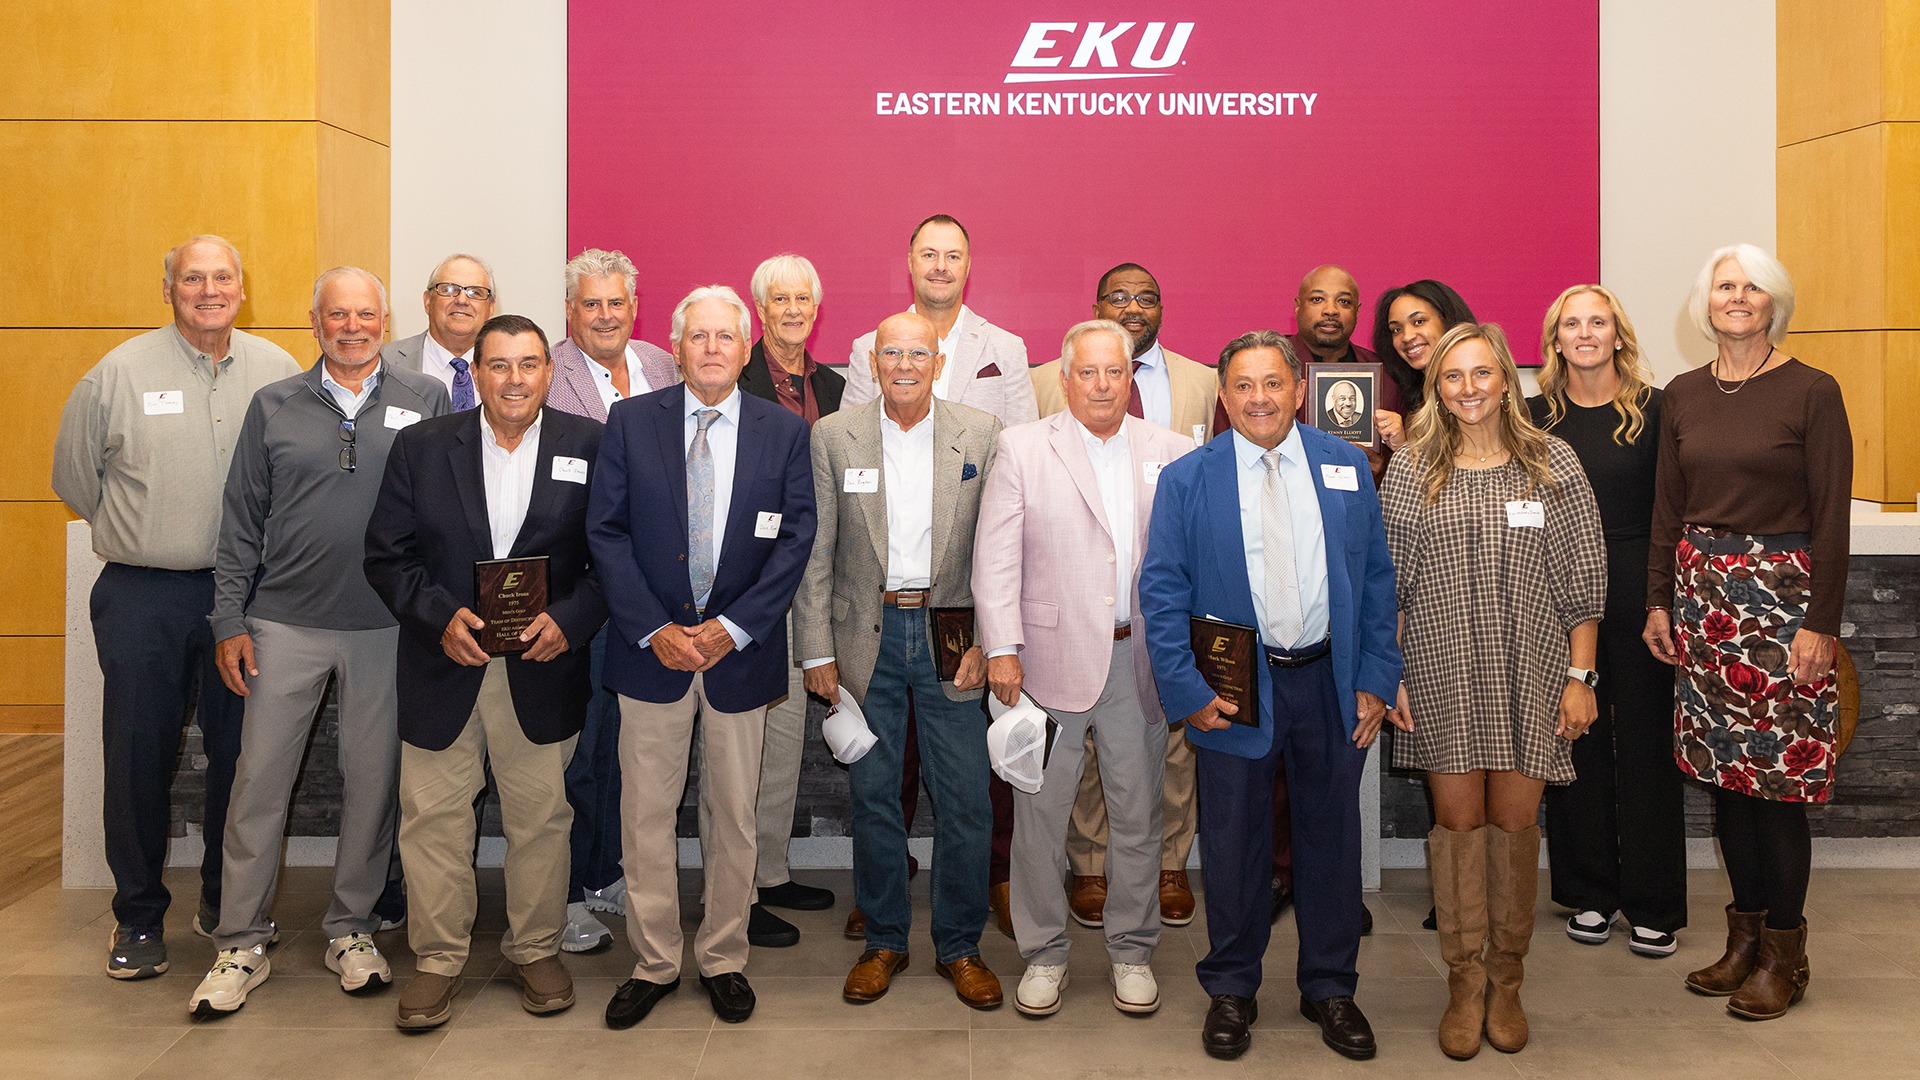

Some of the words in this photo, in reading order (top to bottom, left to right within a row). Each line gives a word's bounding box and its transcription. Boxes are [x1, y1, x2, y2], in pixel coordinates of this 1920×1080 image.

[876, 93, 1000, 116] EASTERN
[1007, 93, 1153, 116] KENTUCKY
[1158, 93, 1318, 116] UNIVERSITY
